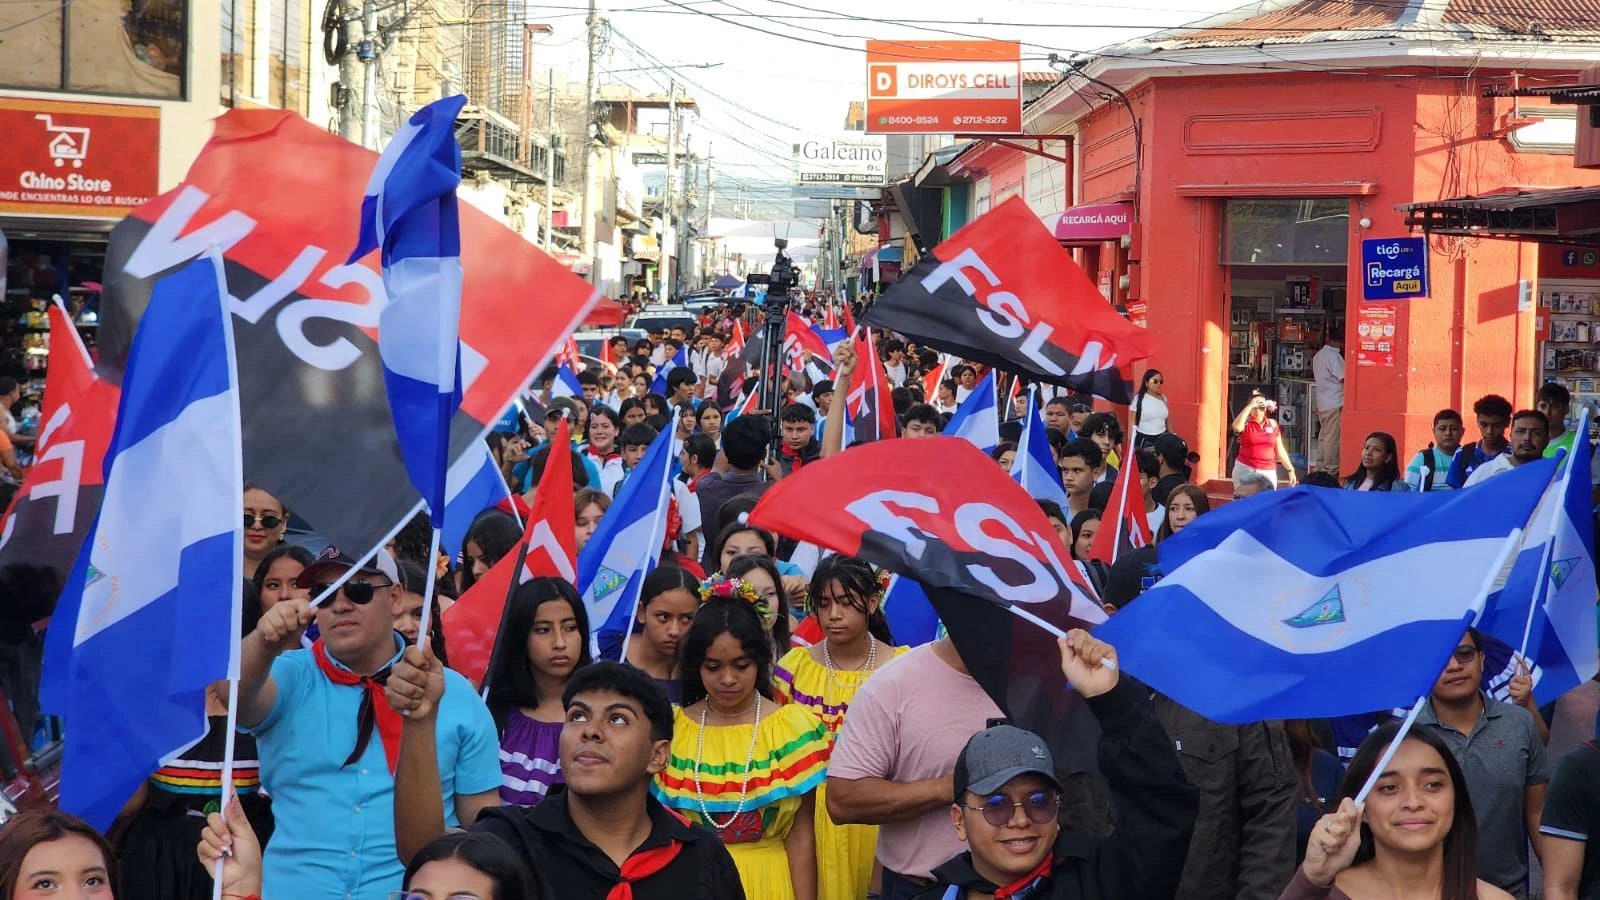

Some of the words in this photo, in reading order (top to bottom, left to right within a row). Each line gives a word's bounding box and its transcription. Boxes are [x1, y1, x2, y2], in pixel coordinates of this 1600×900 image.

[907, 74, 967, 89] DIROYS
[973, 74, 1010, 88] CELL
[888, 116, 939, 124] 8400-8524
[962, 116, 1008, 124] 2712-2272
[803, 141, 882, 161] Galeano
[20, 171, 65, 190] Chino
[67, 173, 112, 192] Store
[0, 191, 18, 200] NDE
[20, 191, 79, 203] ENCUENTRAS
[81, 195, 93, 204] LO
[95, 196, 113, 205] QUE
[1062, 213, 1103, 224] RECARGÁ
[1105, 212, 1126, 225] AQUÍ
[1371, 265, 1420, 279] Recargá
